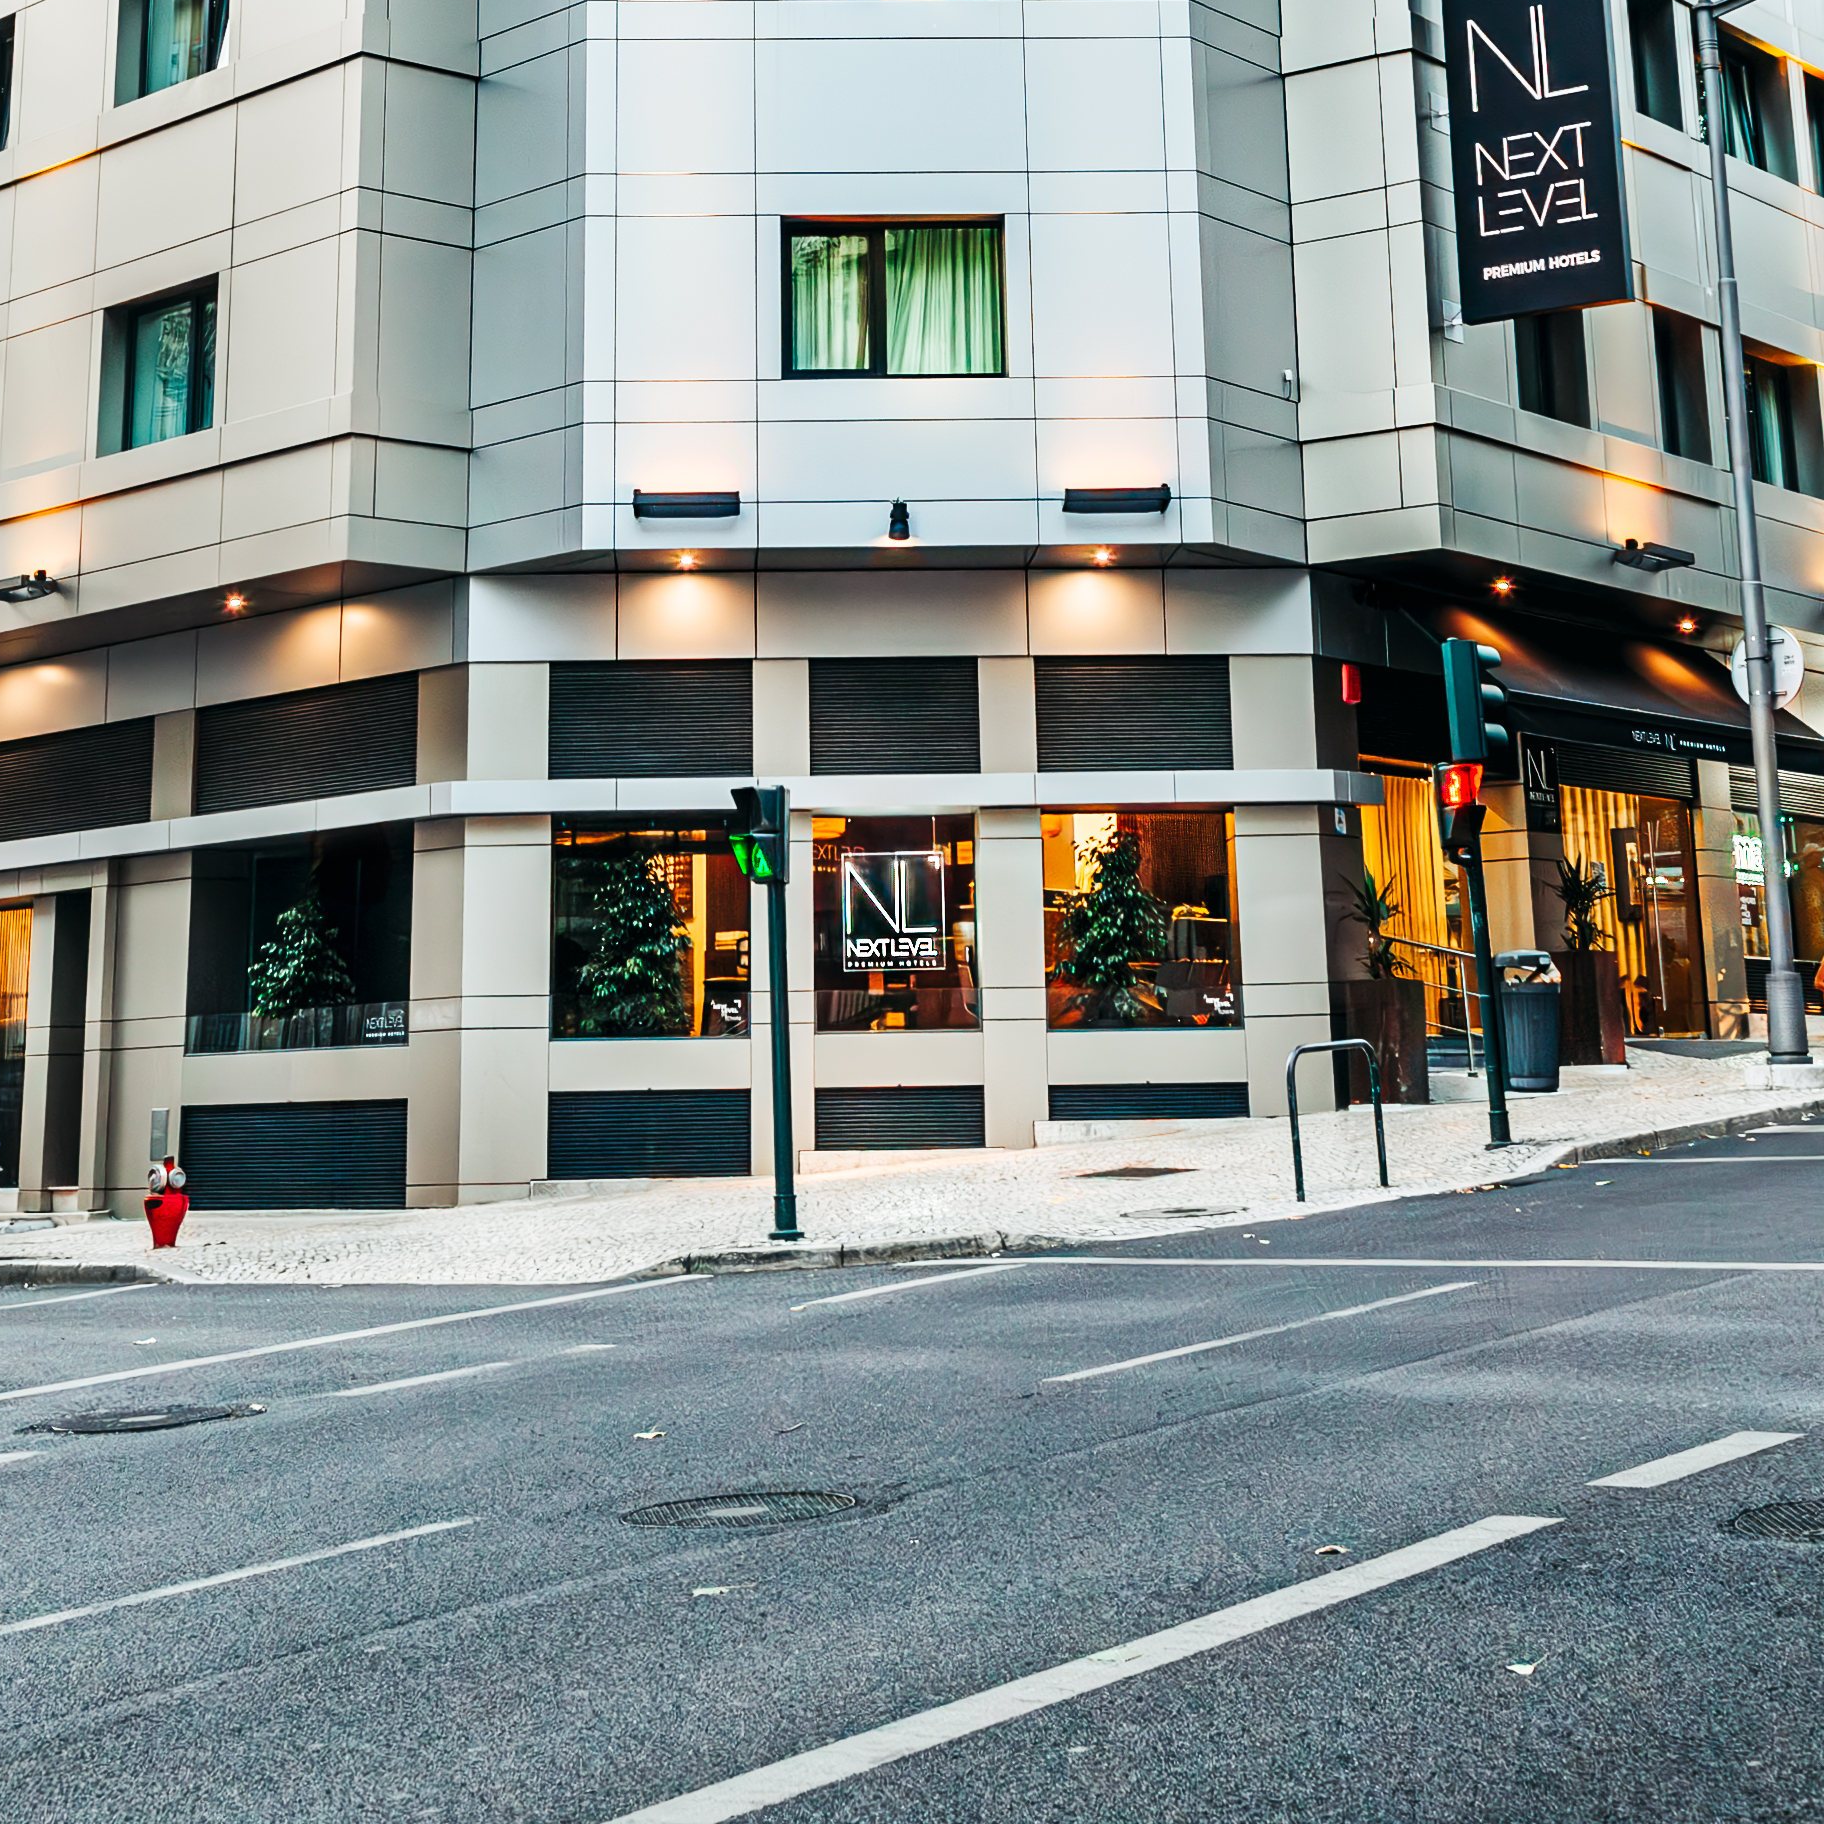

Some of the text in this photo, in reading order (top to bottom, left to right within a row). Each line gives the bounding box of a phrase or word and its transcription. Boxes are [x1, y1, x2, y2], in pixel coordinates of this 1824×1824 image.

[1466, 4, 1589, 113] NL
[1474, 121, 1592, 186] NEXT
[1477, 178, 1599, 237] LEVEL
[1483, 249, 1601, 281] PREMIUM HOTELS
[844, 860, 938, 935] NL
